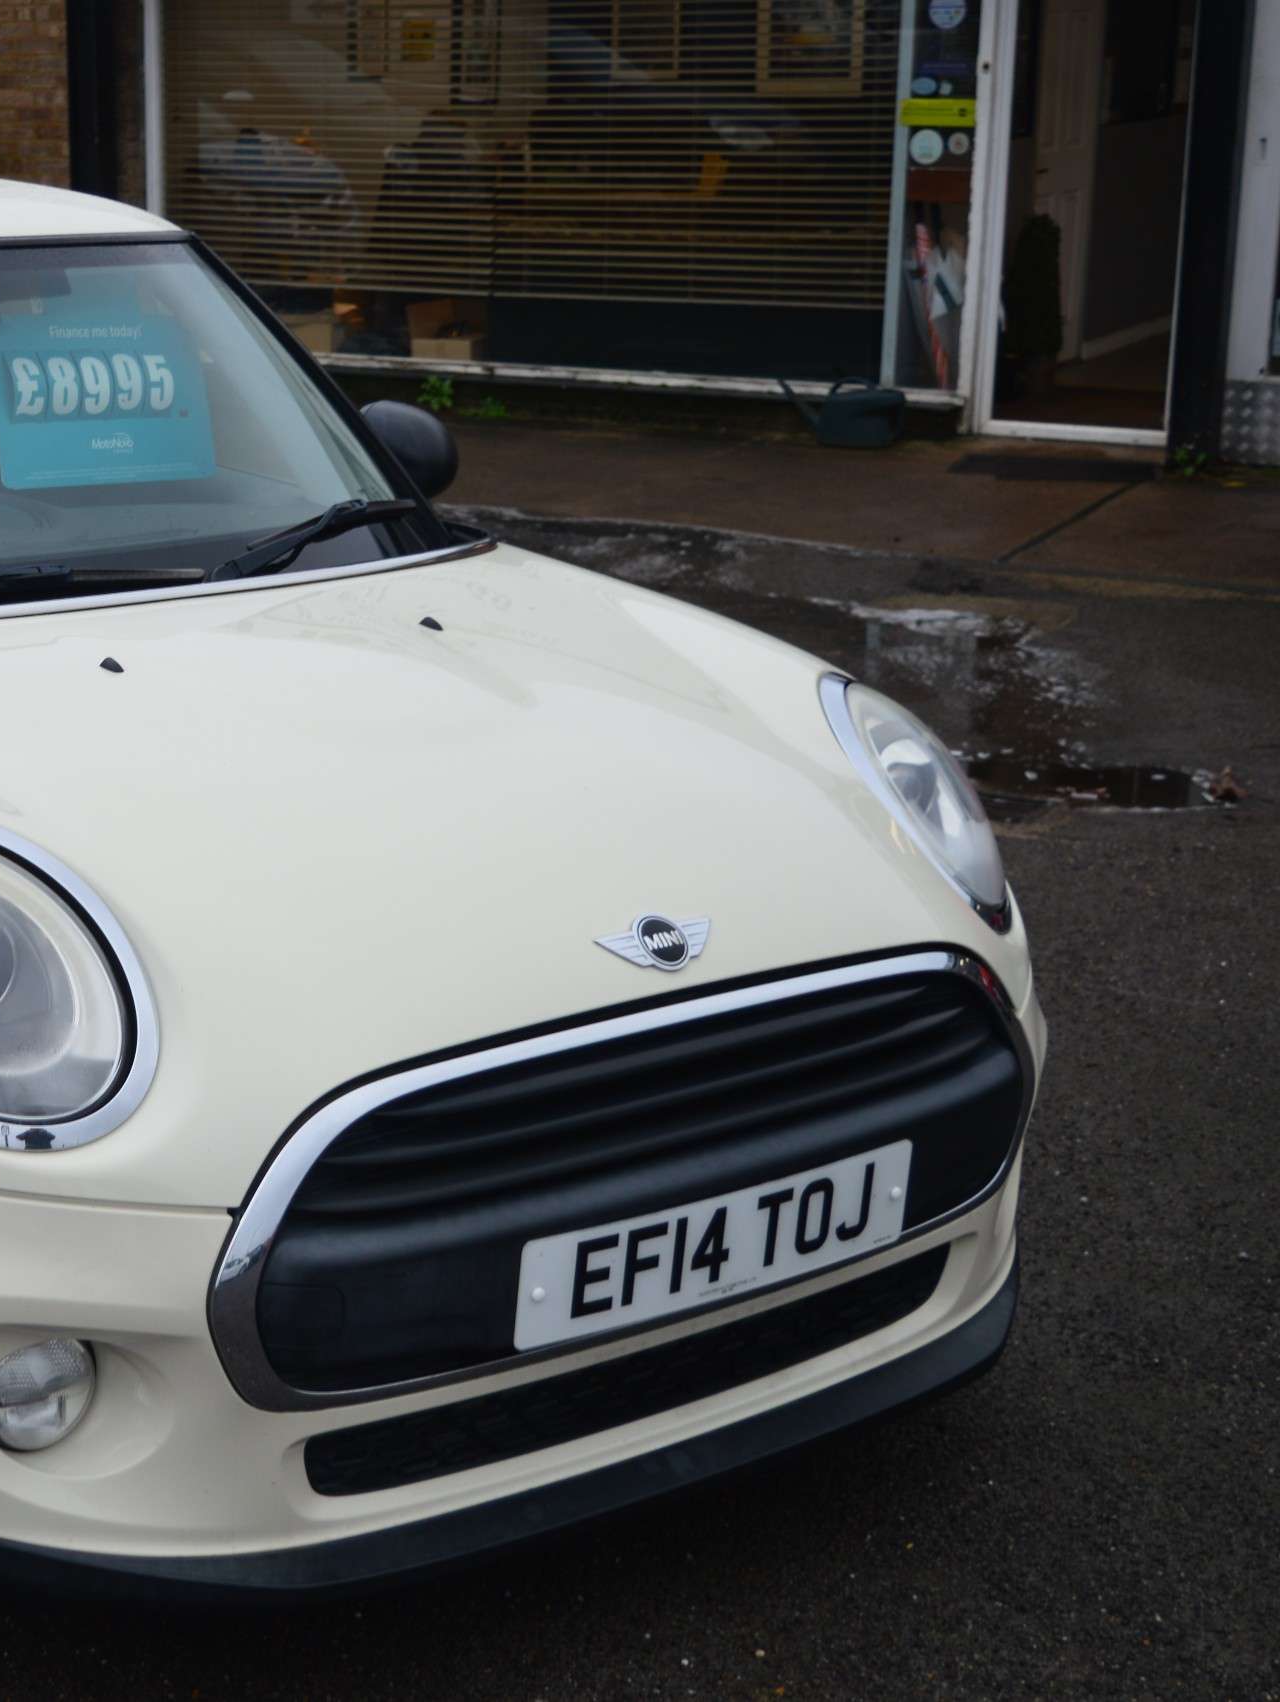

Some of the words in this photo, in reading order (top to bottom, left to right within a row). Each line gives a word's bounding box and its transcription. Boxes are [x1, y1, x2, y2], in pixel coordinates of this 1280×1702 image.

[48, 326, 90, 338] Finance
[91, 328, 109, 338] me
[12, 353, 175, 416] £8995
[643, 929, 684, 951] MINI
[570, 1206, 730, 1319] EF14
[757, 1162, 875, 1268] TOJ
